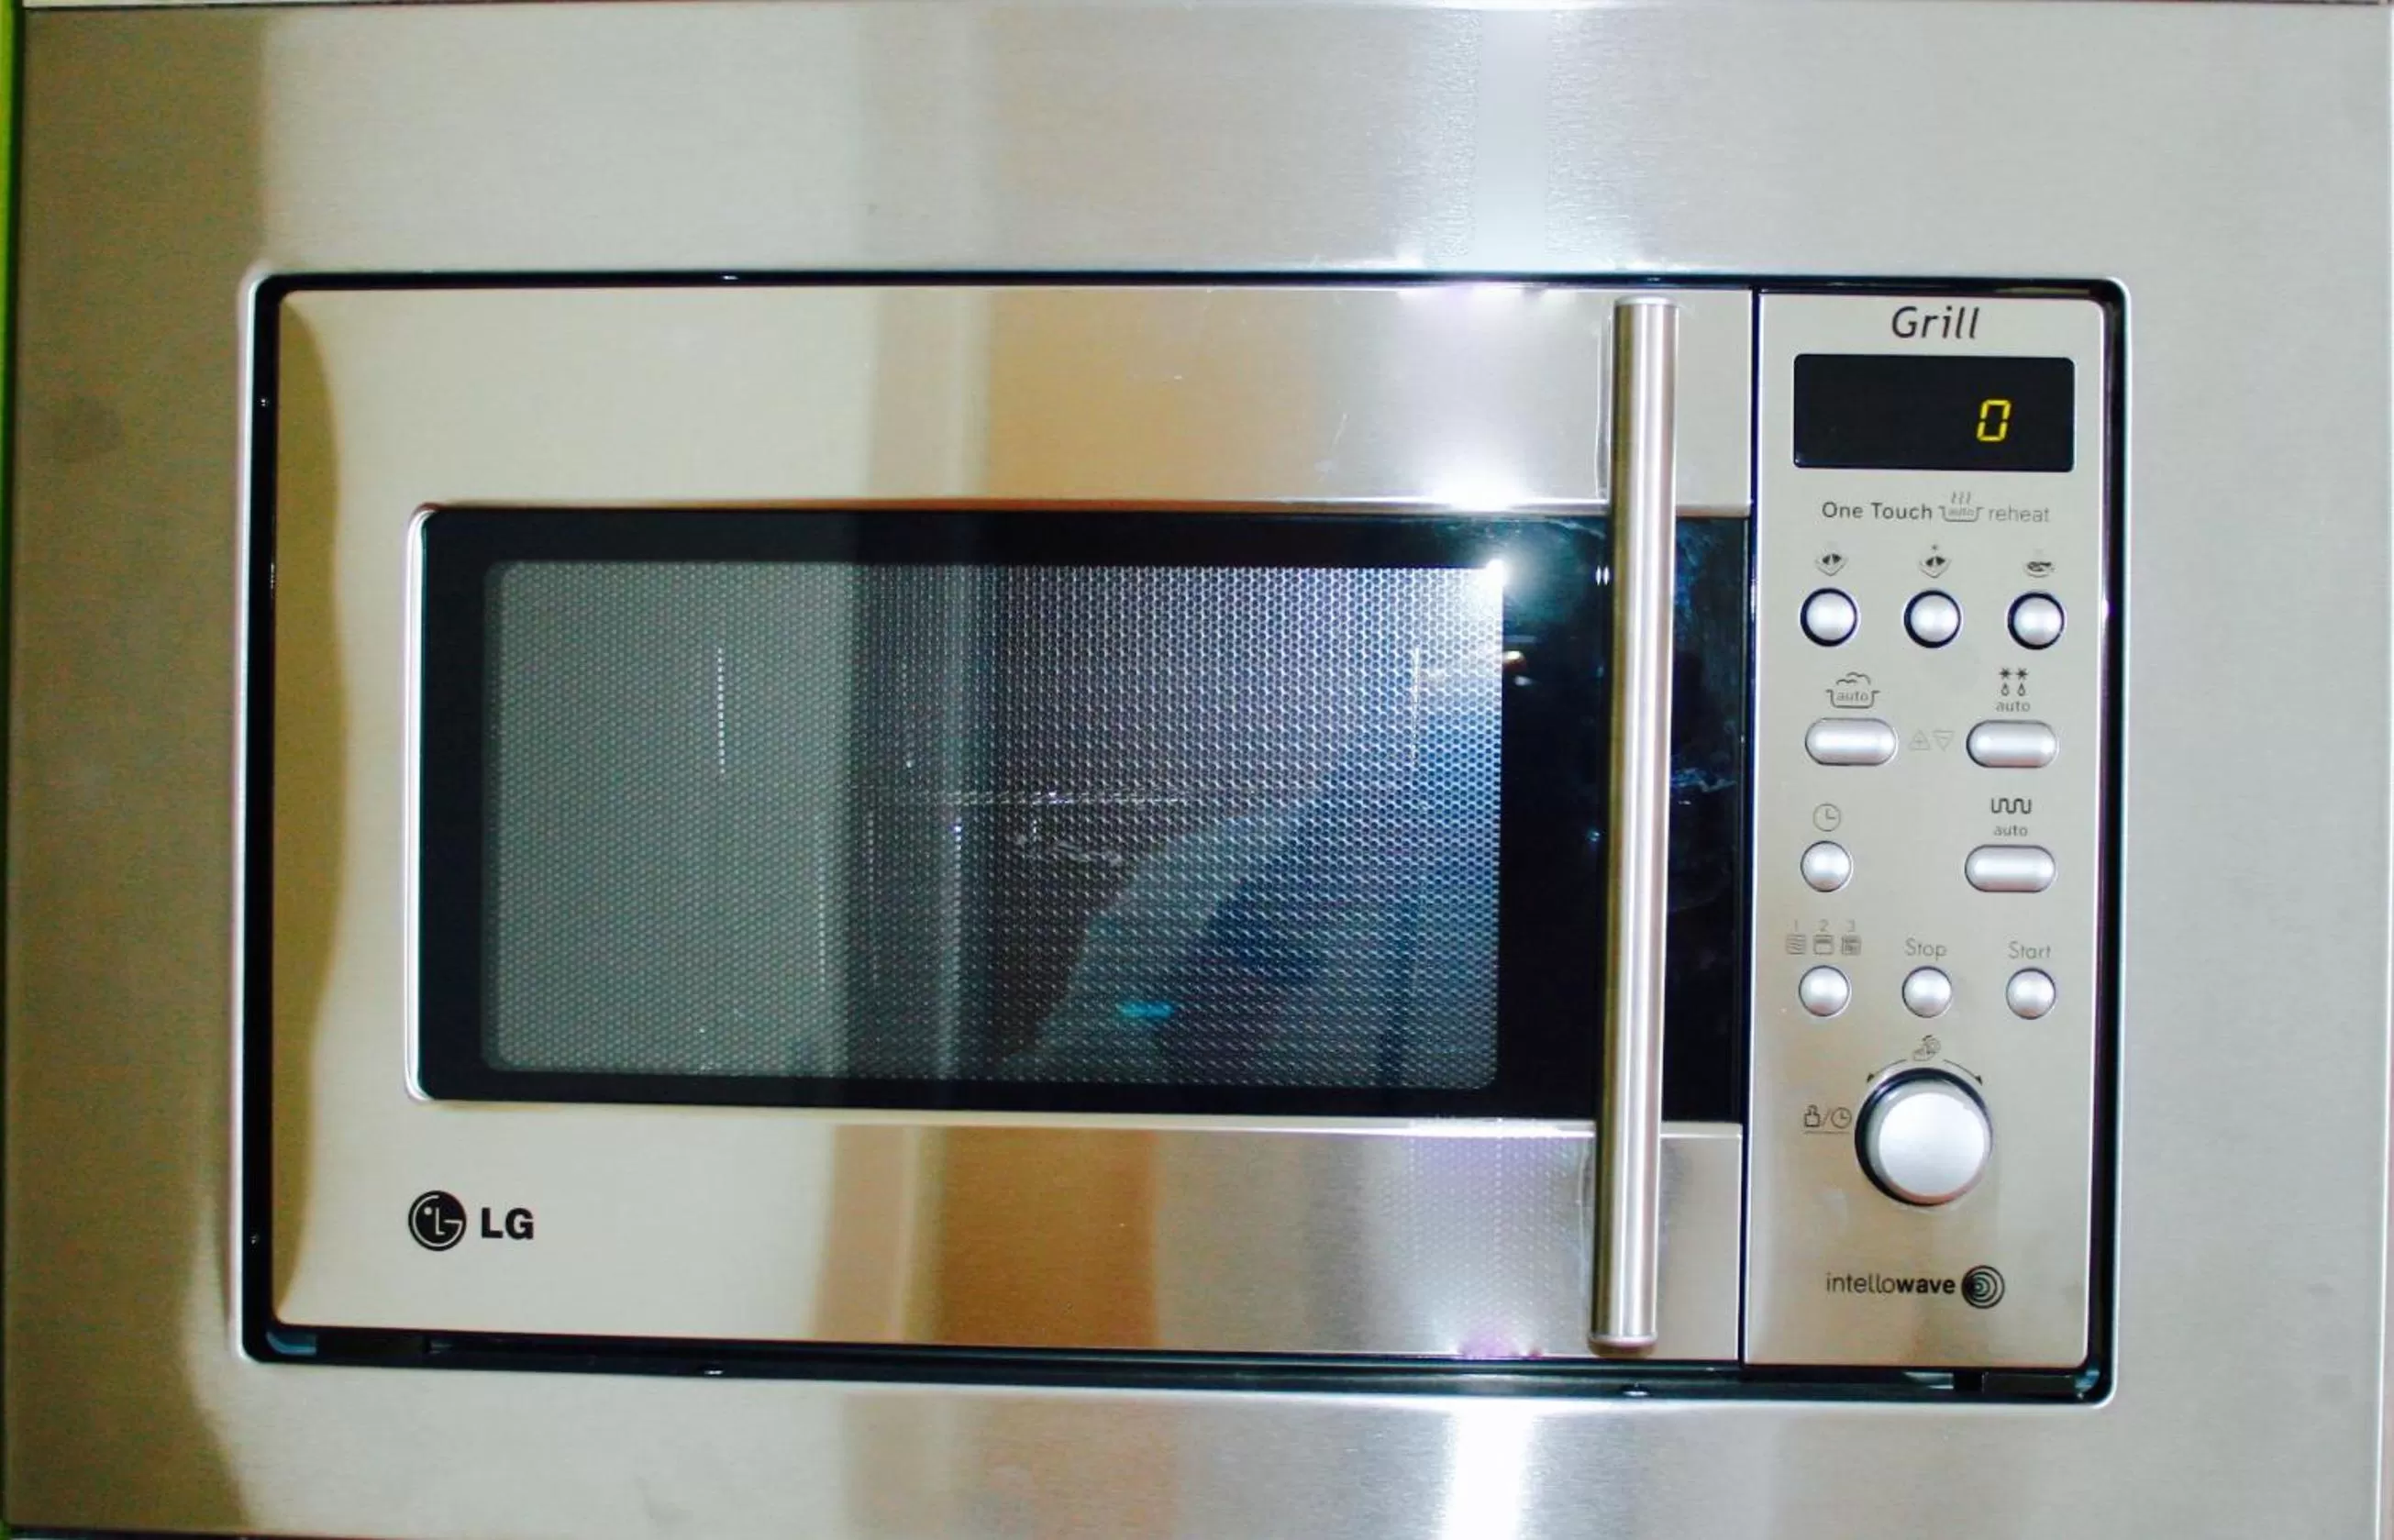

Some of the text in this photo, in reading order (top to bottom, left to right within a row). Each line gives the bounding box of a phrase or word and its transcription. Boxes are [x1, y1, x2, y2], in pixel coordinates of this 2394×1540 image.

[1891, 305, 1979, 340] Grill
[1976, 399, 2011, 442] 0
[1822, 501, 1864, 518] One
[1870, 502, 1933, 520] Touch
[1988, 505, 2050, 523] reheat
[1836, 690, 1868, 703] auto
[1995, 700, 2031, 713] auto
[1993, 824, 2028, 836] auto
[1819, 919, 1829, 932] 2
[1905, 936, 1947, 960] Stop
[2008, 940, 2052, 959] Start
[481, 1207, 534, 1239] LG
[1826, 1271, 1956, 1295] intellowave
